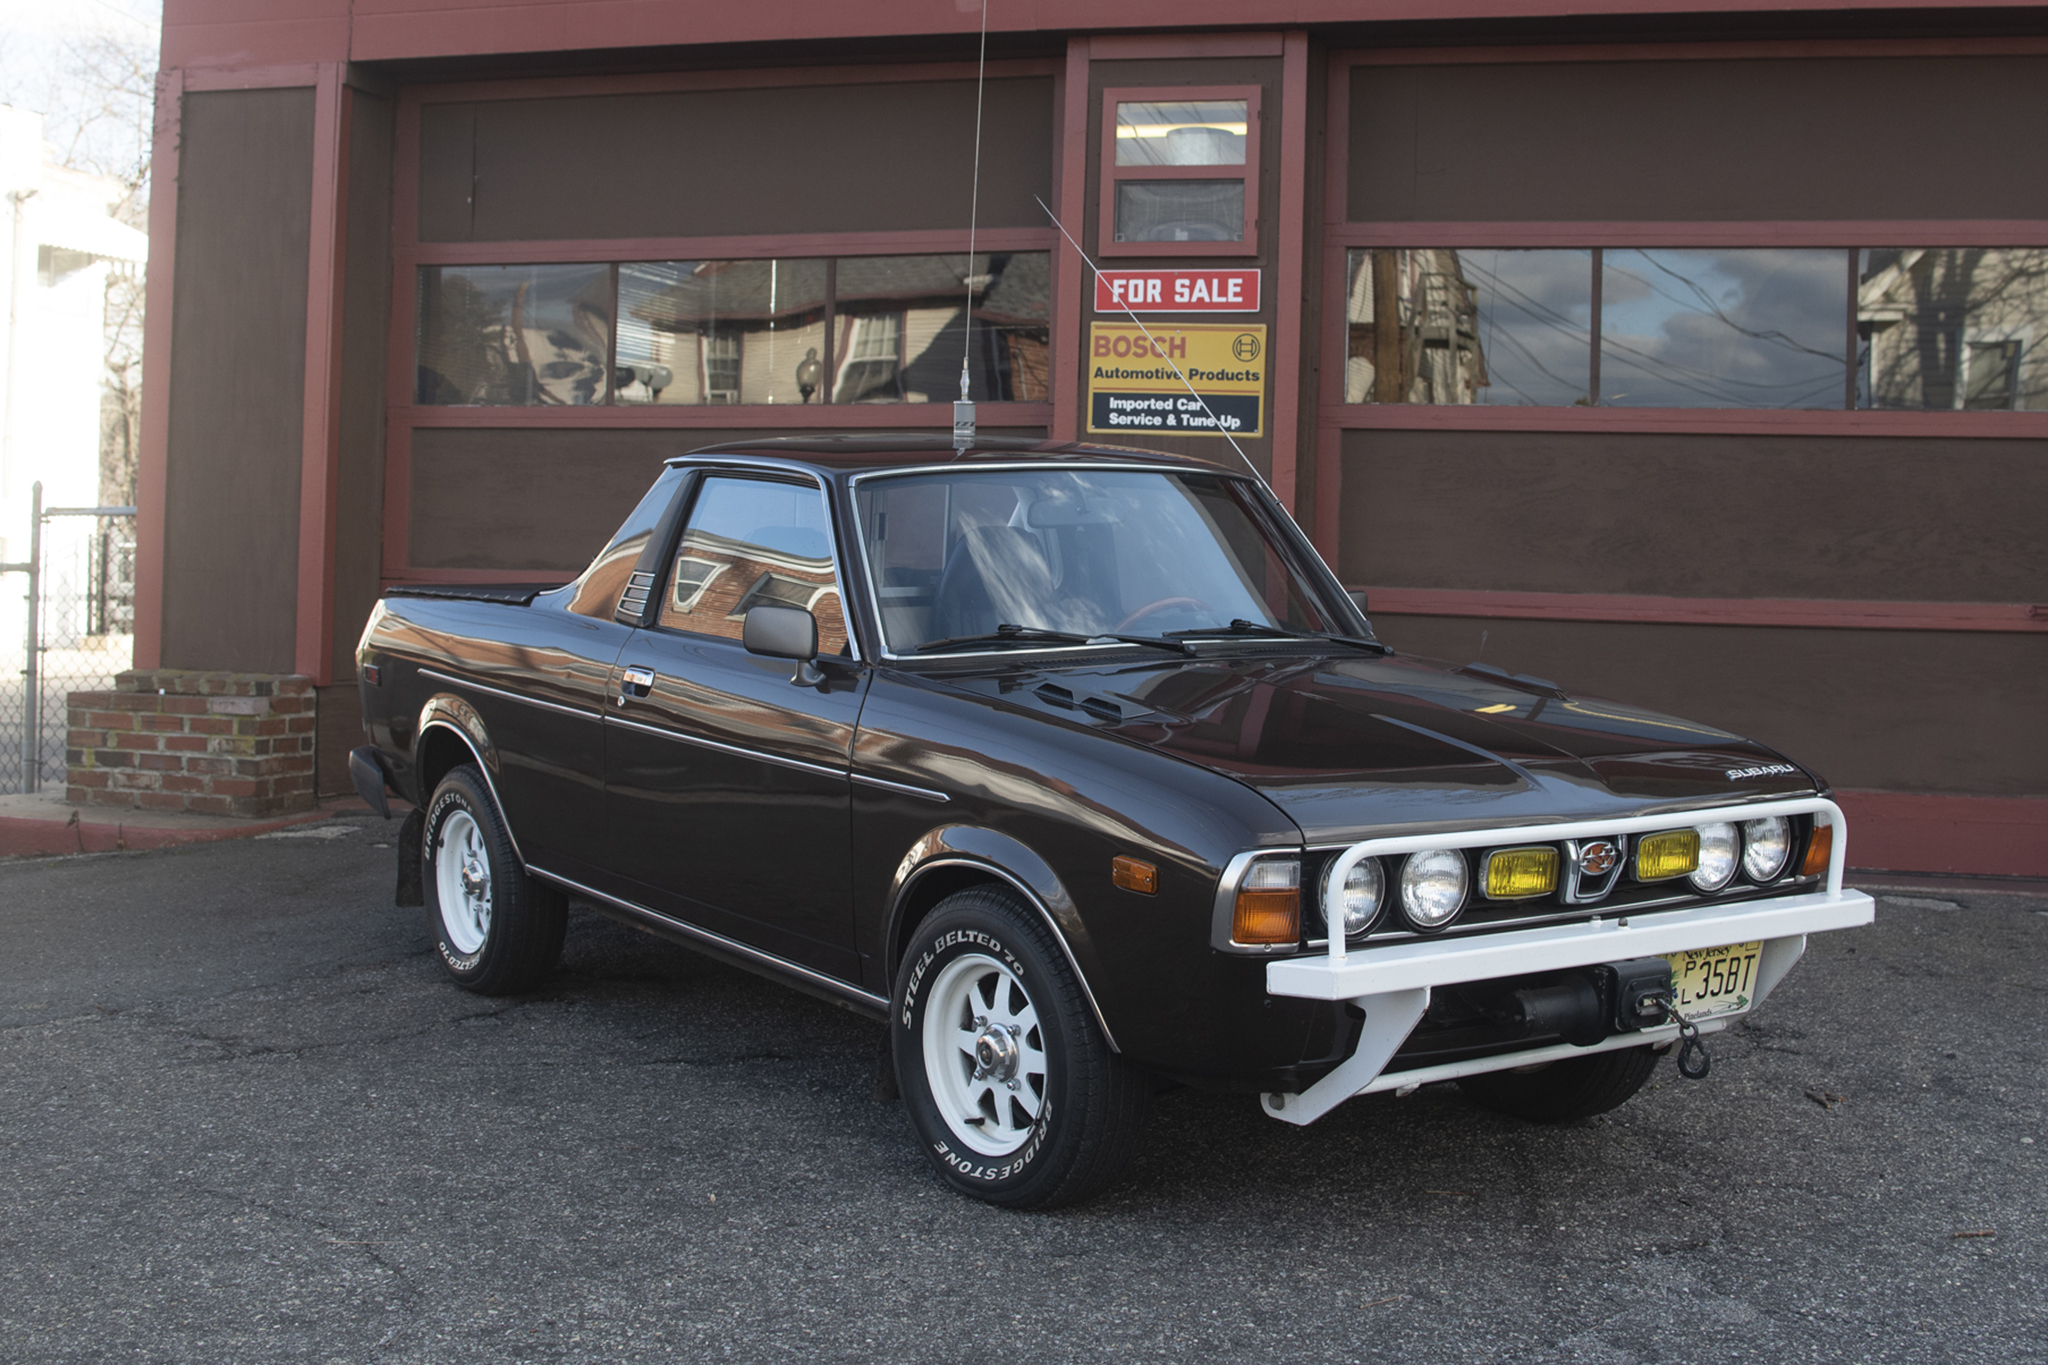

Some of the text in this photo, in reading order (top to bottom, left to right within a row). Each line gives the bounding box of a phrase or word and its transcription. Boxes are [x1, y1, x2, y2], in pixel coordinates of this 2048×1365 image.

[1112, 278, 1243, 303] FOR SALE
[1093, 335, 1187, 359] BOSCH
[1093, 366, 1260, 382] Automotive Products
[1109, 397, 1202, 412] Imported Car
[1109, 412, 1163, 426] Service
[1166, 414, 1177, 426] &
[1725, 764, 1795, 781] SUBARU
[424, 792, 473, 860] BRIDGESTONE
[438, 941, 450, 959] 70
[1682, 945, 1732, 961] New Jersey
[902, 930, 1024, 1030] STEEL BELTED 70
[1696, 954, 1756, 1000] 35BT
[933, 1099, 1053, 1180] BRIDGESTONE
